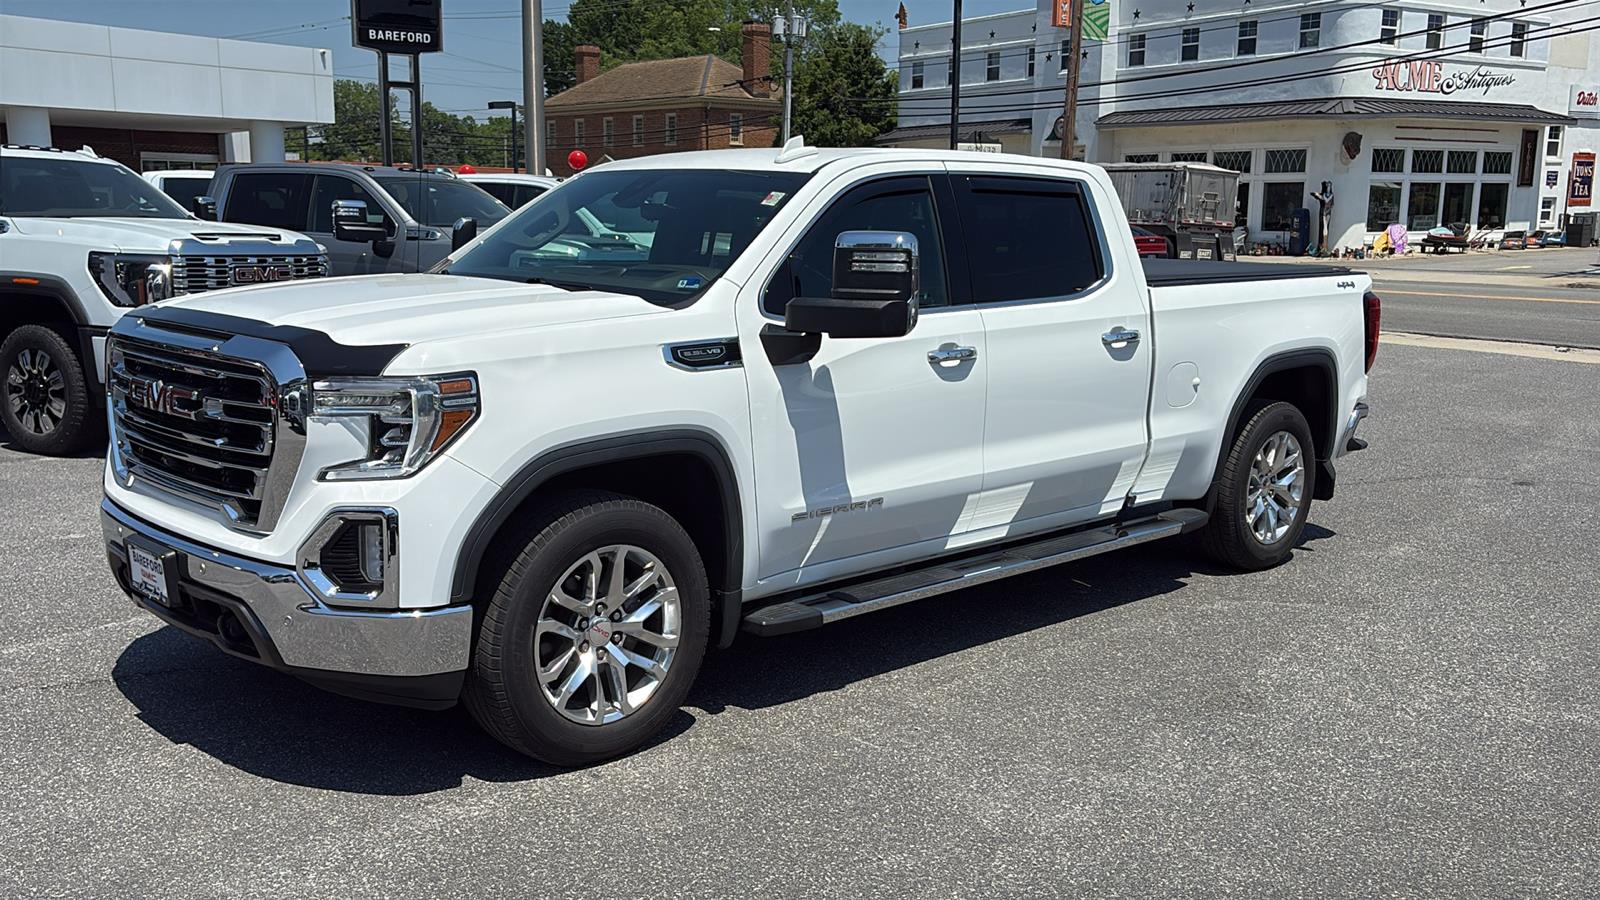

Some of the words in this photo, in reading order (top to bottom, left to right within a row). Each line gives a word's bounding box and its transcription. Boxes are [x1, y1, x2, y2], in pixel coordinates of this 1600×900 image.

[368, 29, 431, 44] BAREFORD
[1372, 58, 1443, 94] ACME
[1459, 64, 1516, 96] Antiques
[1576, 91, 1598, 106] Dutch
[1574, 183, 1589, 196] TEA
[235, 266, 293, 282] GMC
[128, 379, 202, 420] GMC
[791, 496, 884, 521] SIERRA
